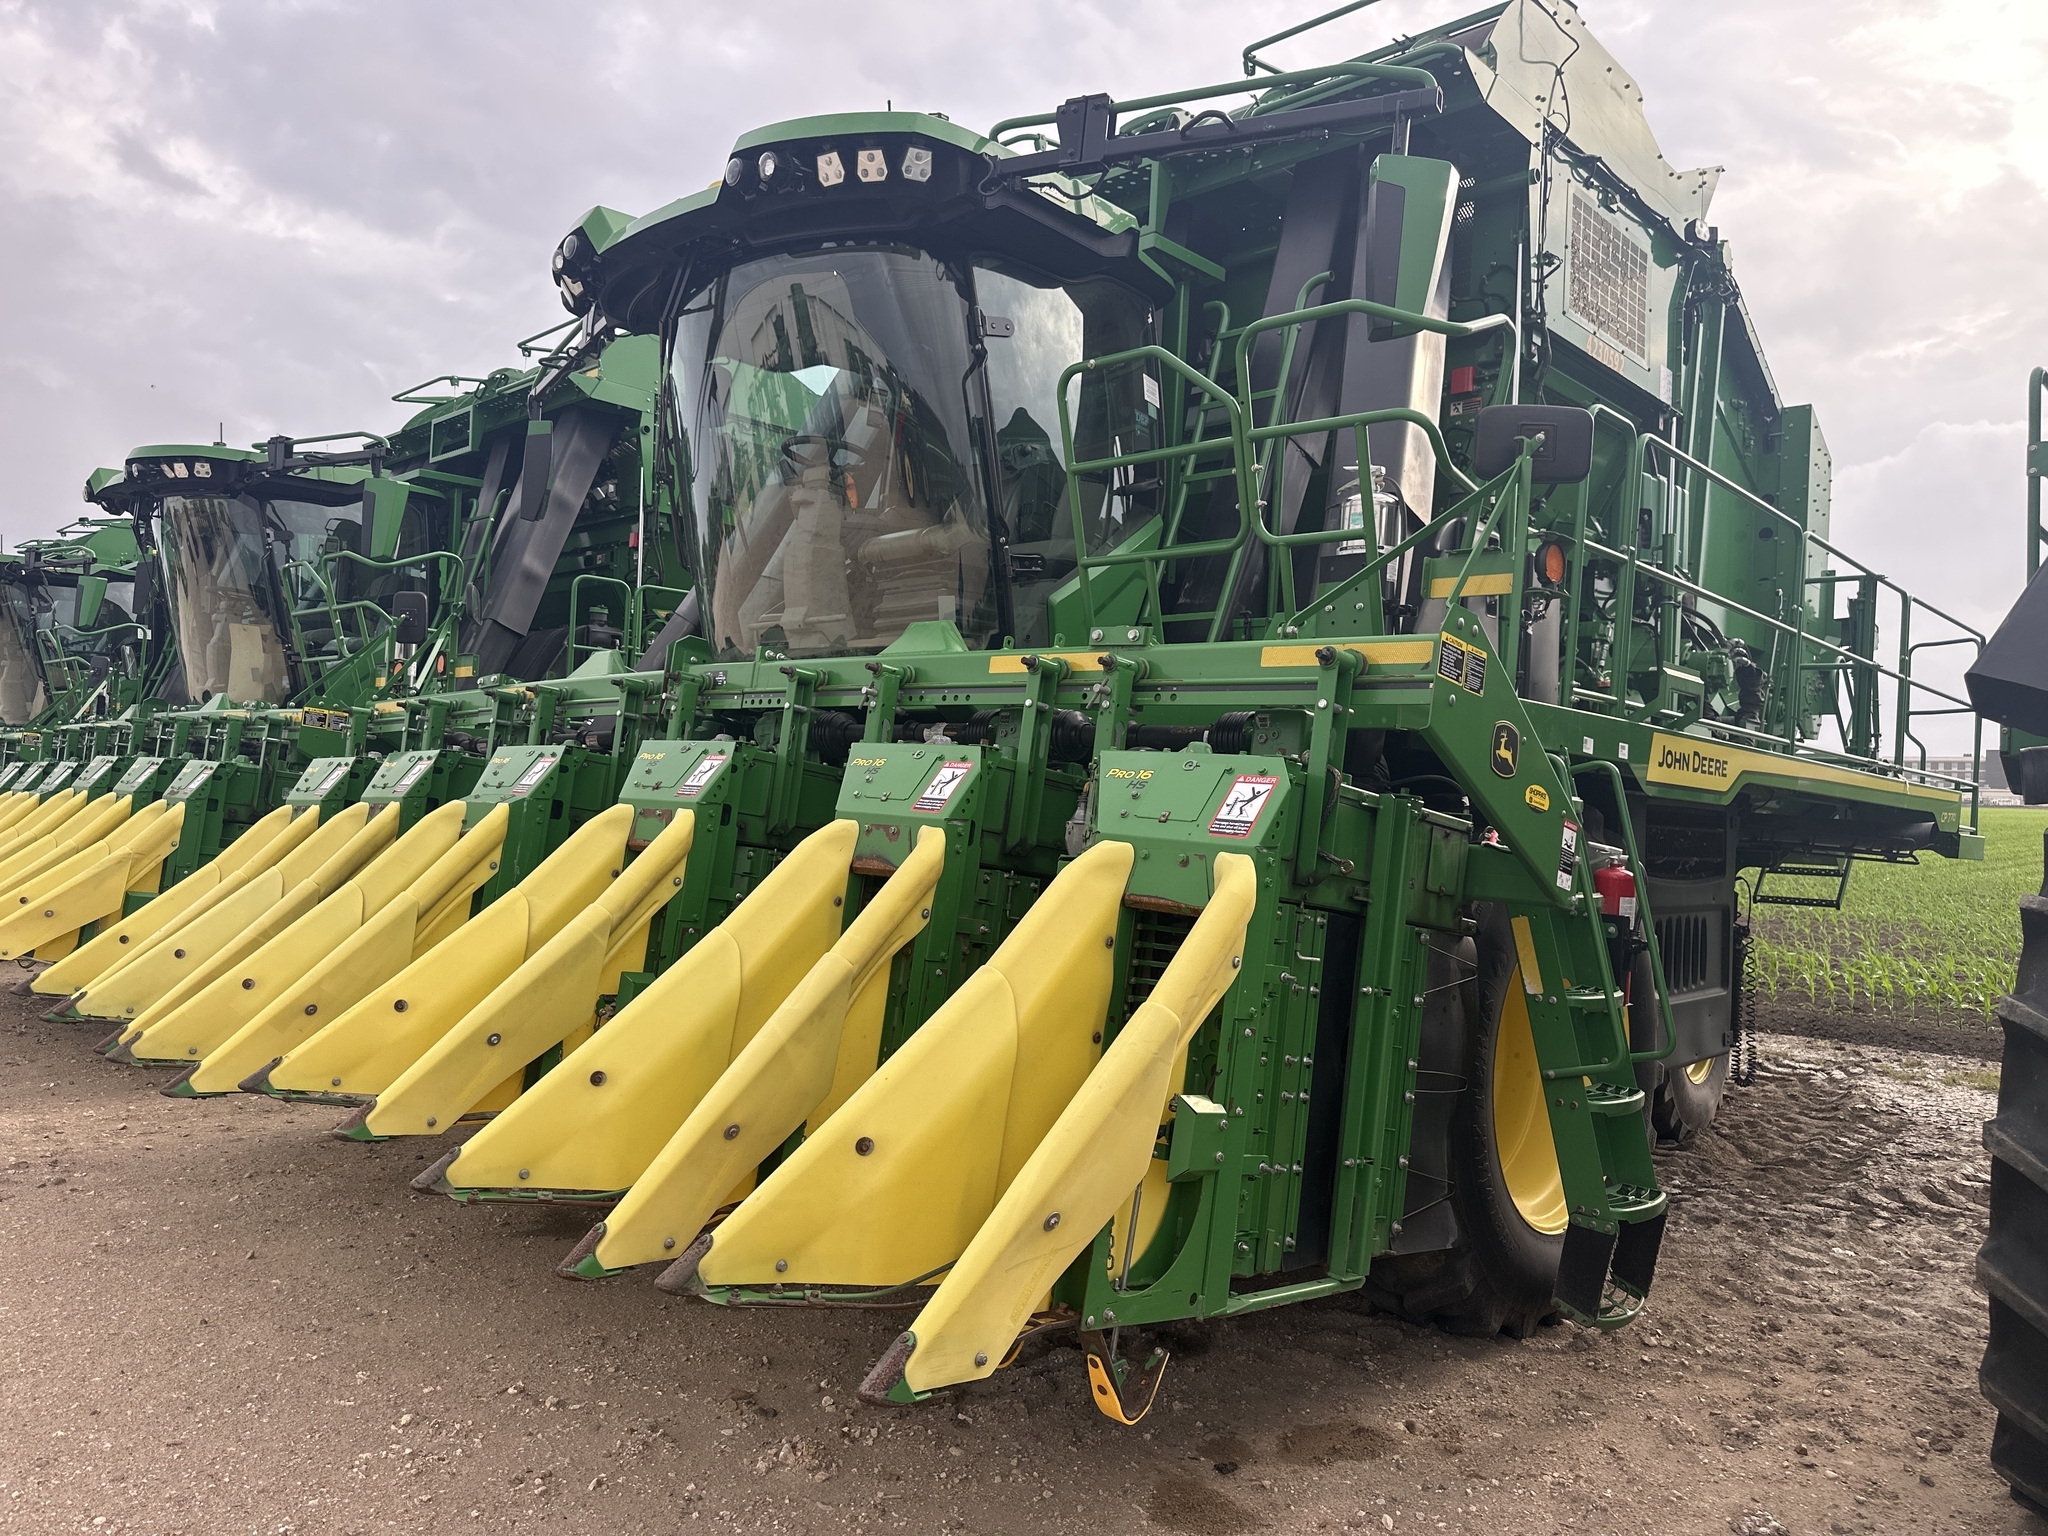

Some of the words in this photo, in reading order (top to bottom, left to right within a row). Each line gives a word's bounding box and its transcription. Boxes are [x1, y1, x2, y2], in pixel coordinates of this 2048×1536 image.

[850, 758, 873, 767] PRO
[872, 758, 888, 767] 16
[1657, 745, 1691, 772] JOHN
[1692, 751, 1728, 778] DEERE
[1105, 768, 1136, 779] PRO
[1135, 769, 1155, 780] 16
[1126, 780, 1149, 789] HS
[1245, 776, 1278, 784] DANGER
